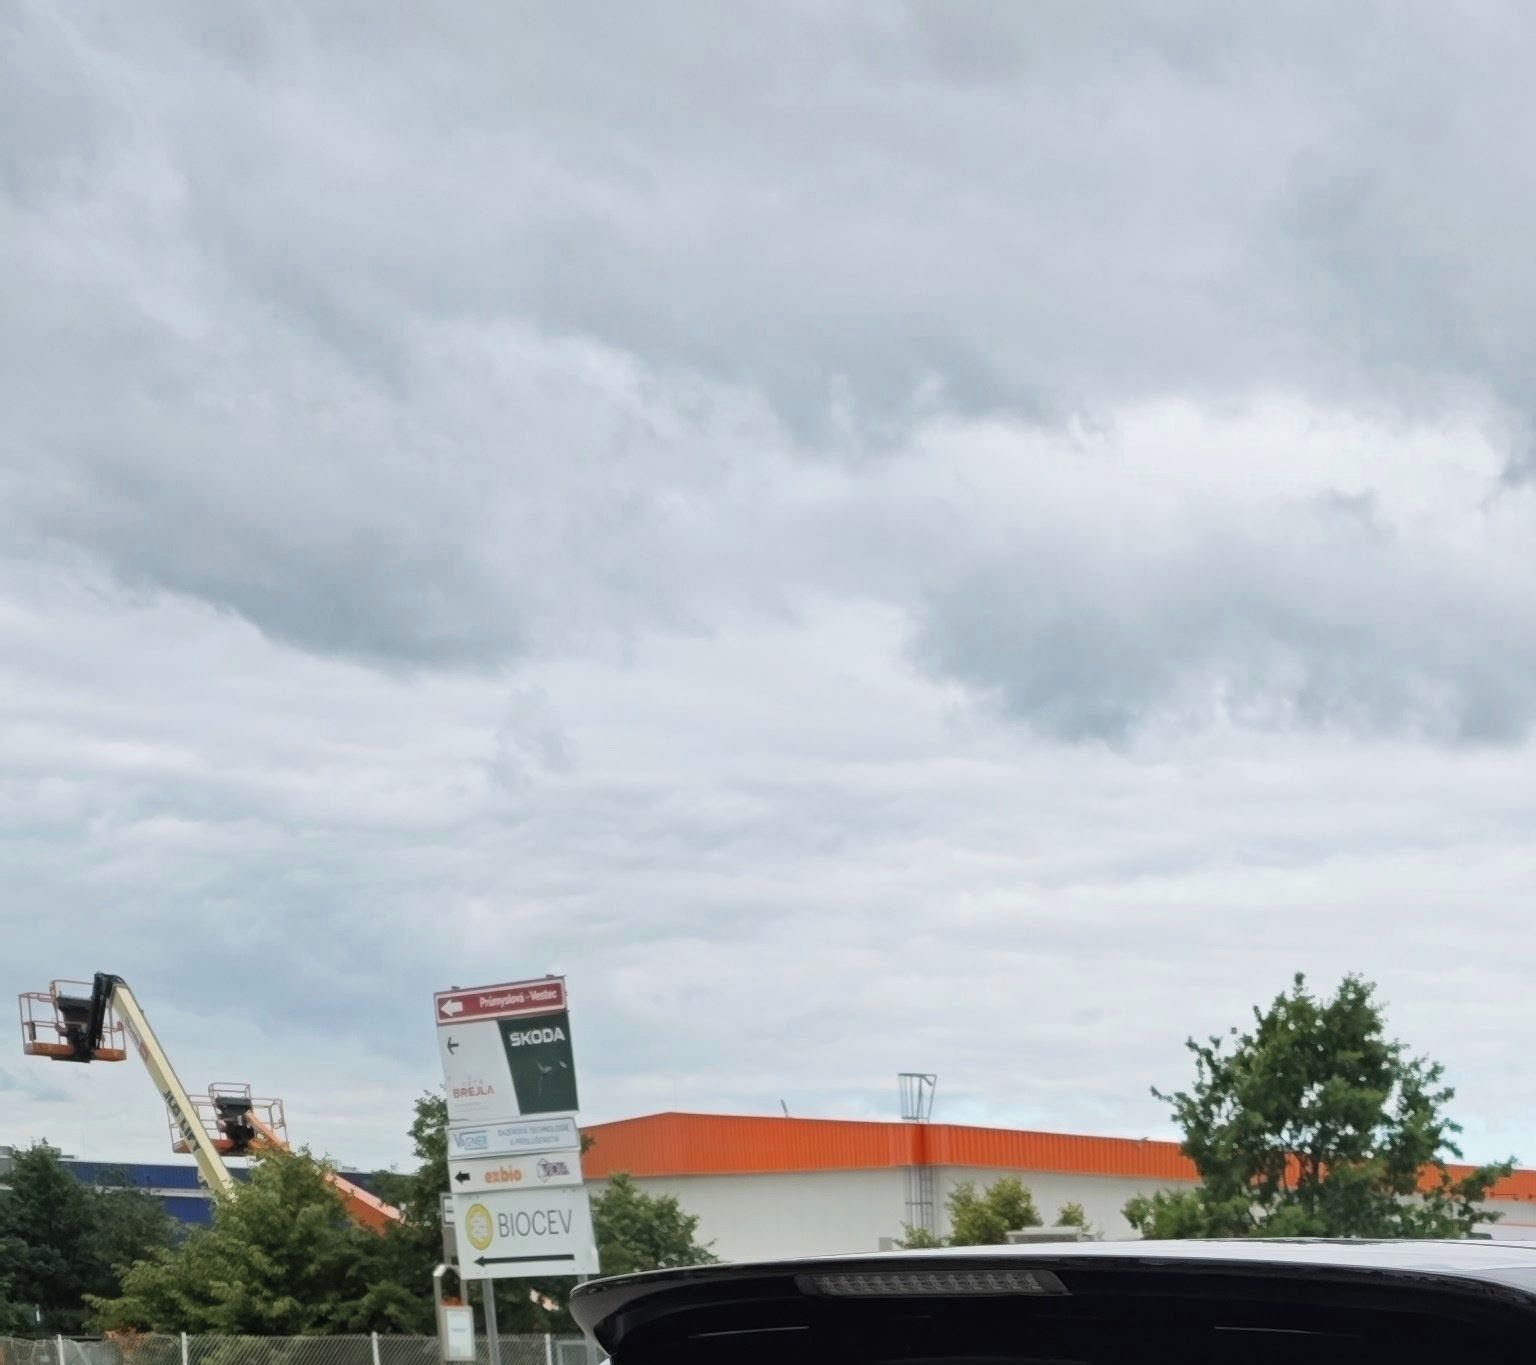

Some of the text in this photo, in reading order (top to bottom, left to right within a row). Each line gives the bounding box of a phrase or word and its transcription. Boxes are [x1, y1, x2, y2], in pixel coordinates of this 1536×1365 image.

[529, 989, 558, 1001] Vestec
[453, 1085, 495, 1099] BREJLA
[485, 1165, 522, 1183] exbio
[498, 1209, 573, 1238] BIOCEV
